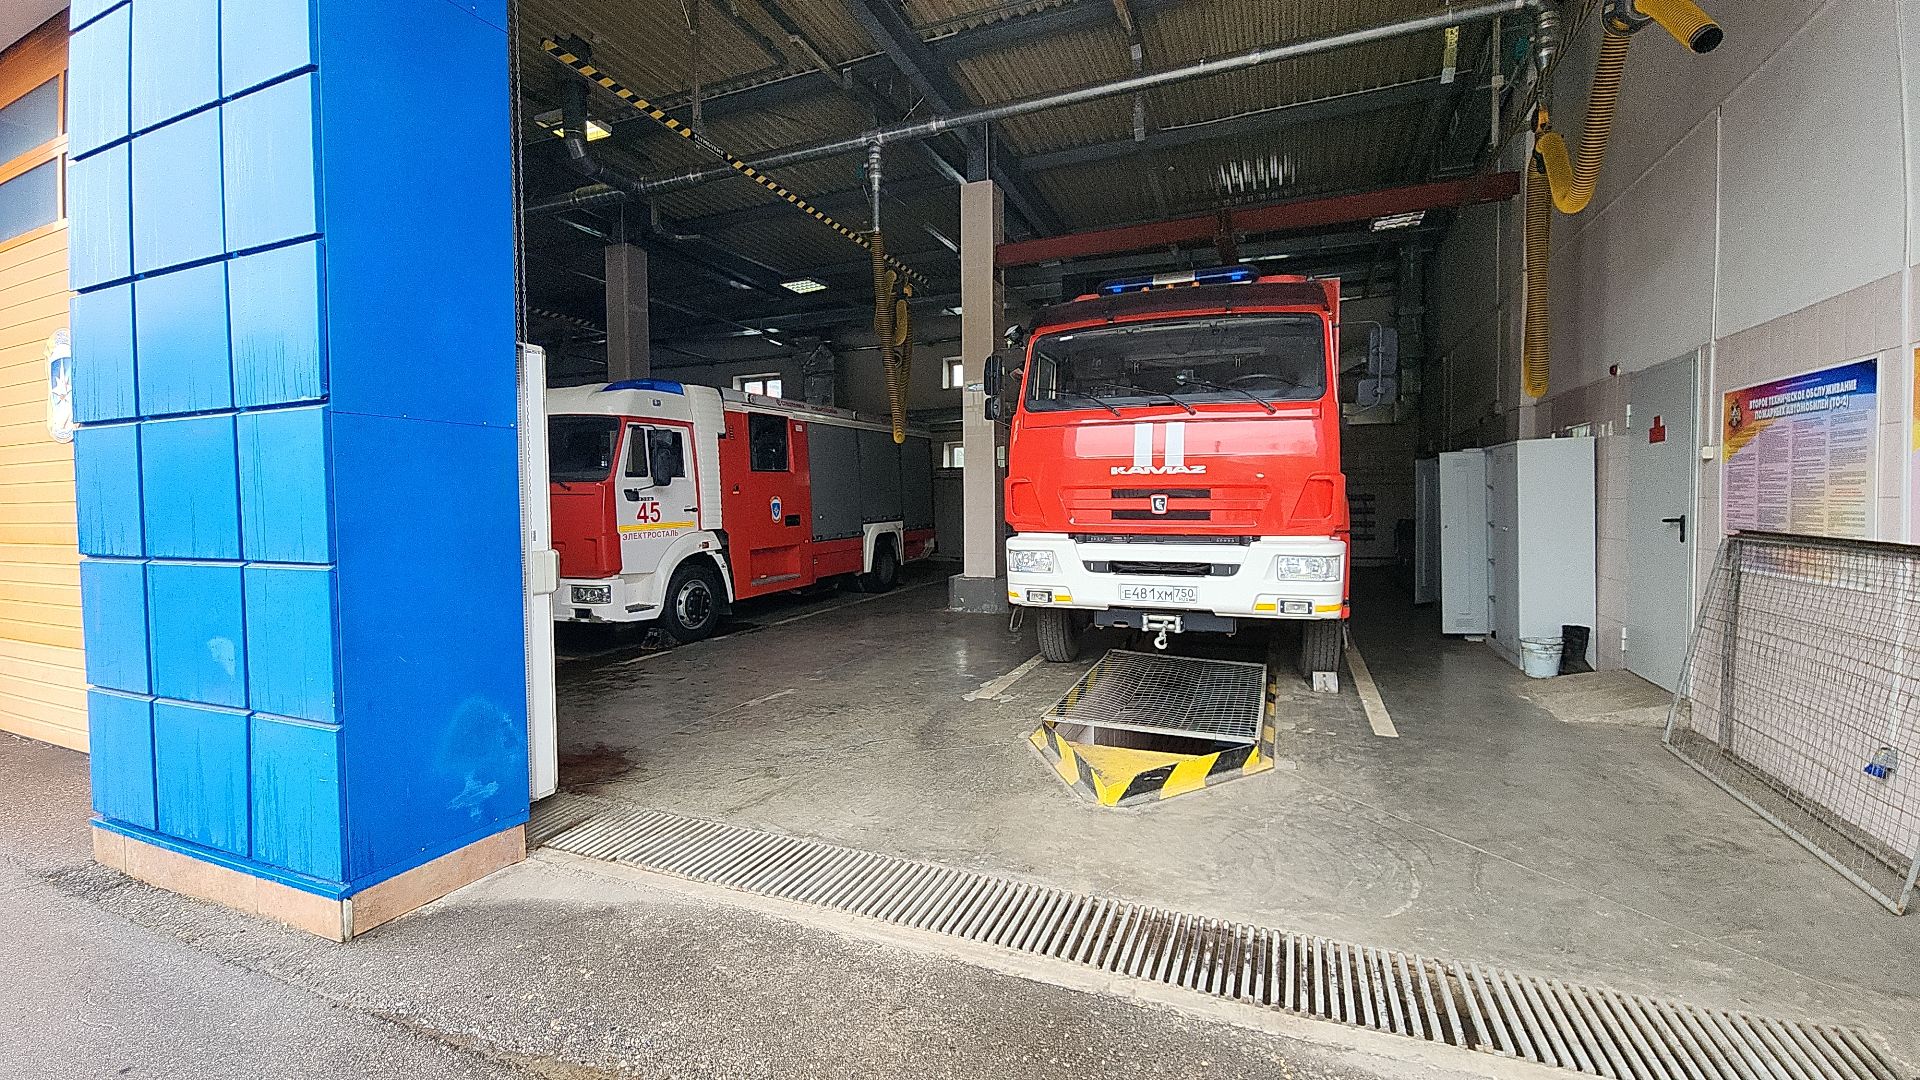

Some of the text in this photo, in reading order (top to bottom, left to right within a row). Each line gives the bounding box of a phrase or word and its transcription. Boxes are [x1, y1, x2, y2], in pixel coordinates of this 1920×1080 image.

[1749, 397, 1769, 409] ВТОРОЕ
[1769, 391, 1805, 406] ТЕХНИЧЕСКОЕ
[1806, 379, 1857, 399] ОБСЛУЖИВАНИЕ
[1755, 395, 1850, 420] ПОЖАРНЫХ АВТОМОБИЛЕЙ (ТО-2)
[1110, 465, 1207, 475] KAMAZ
[637, 502, 661, 523] 45
[622, 530, 679, 541] ЭЛЕКТРОСТАЛЬ
